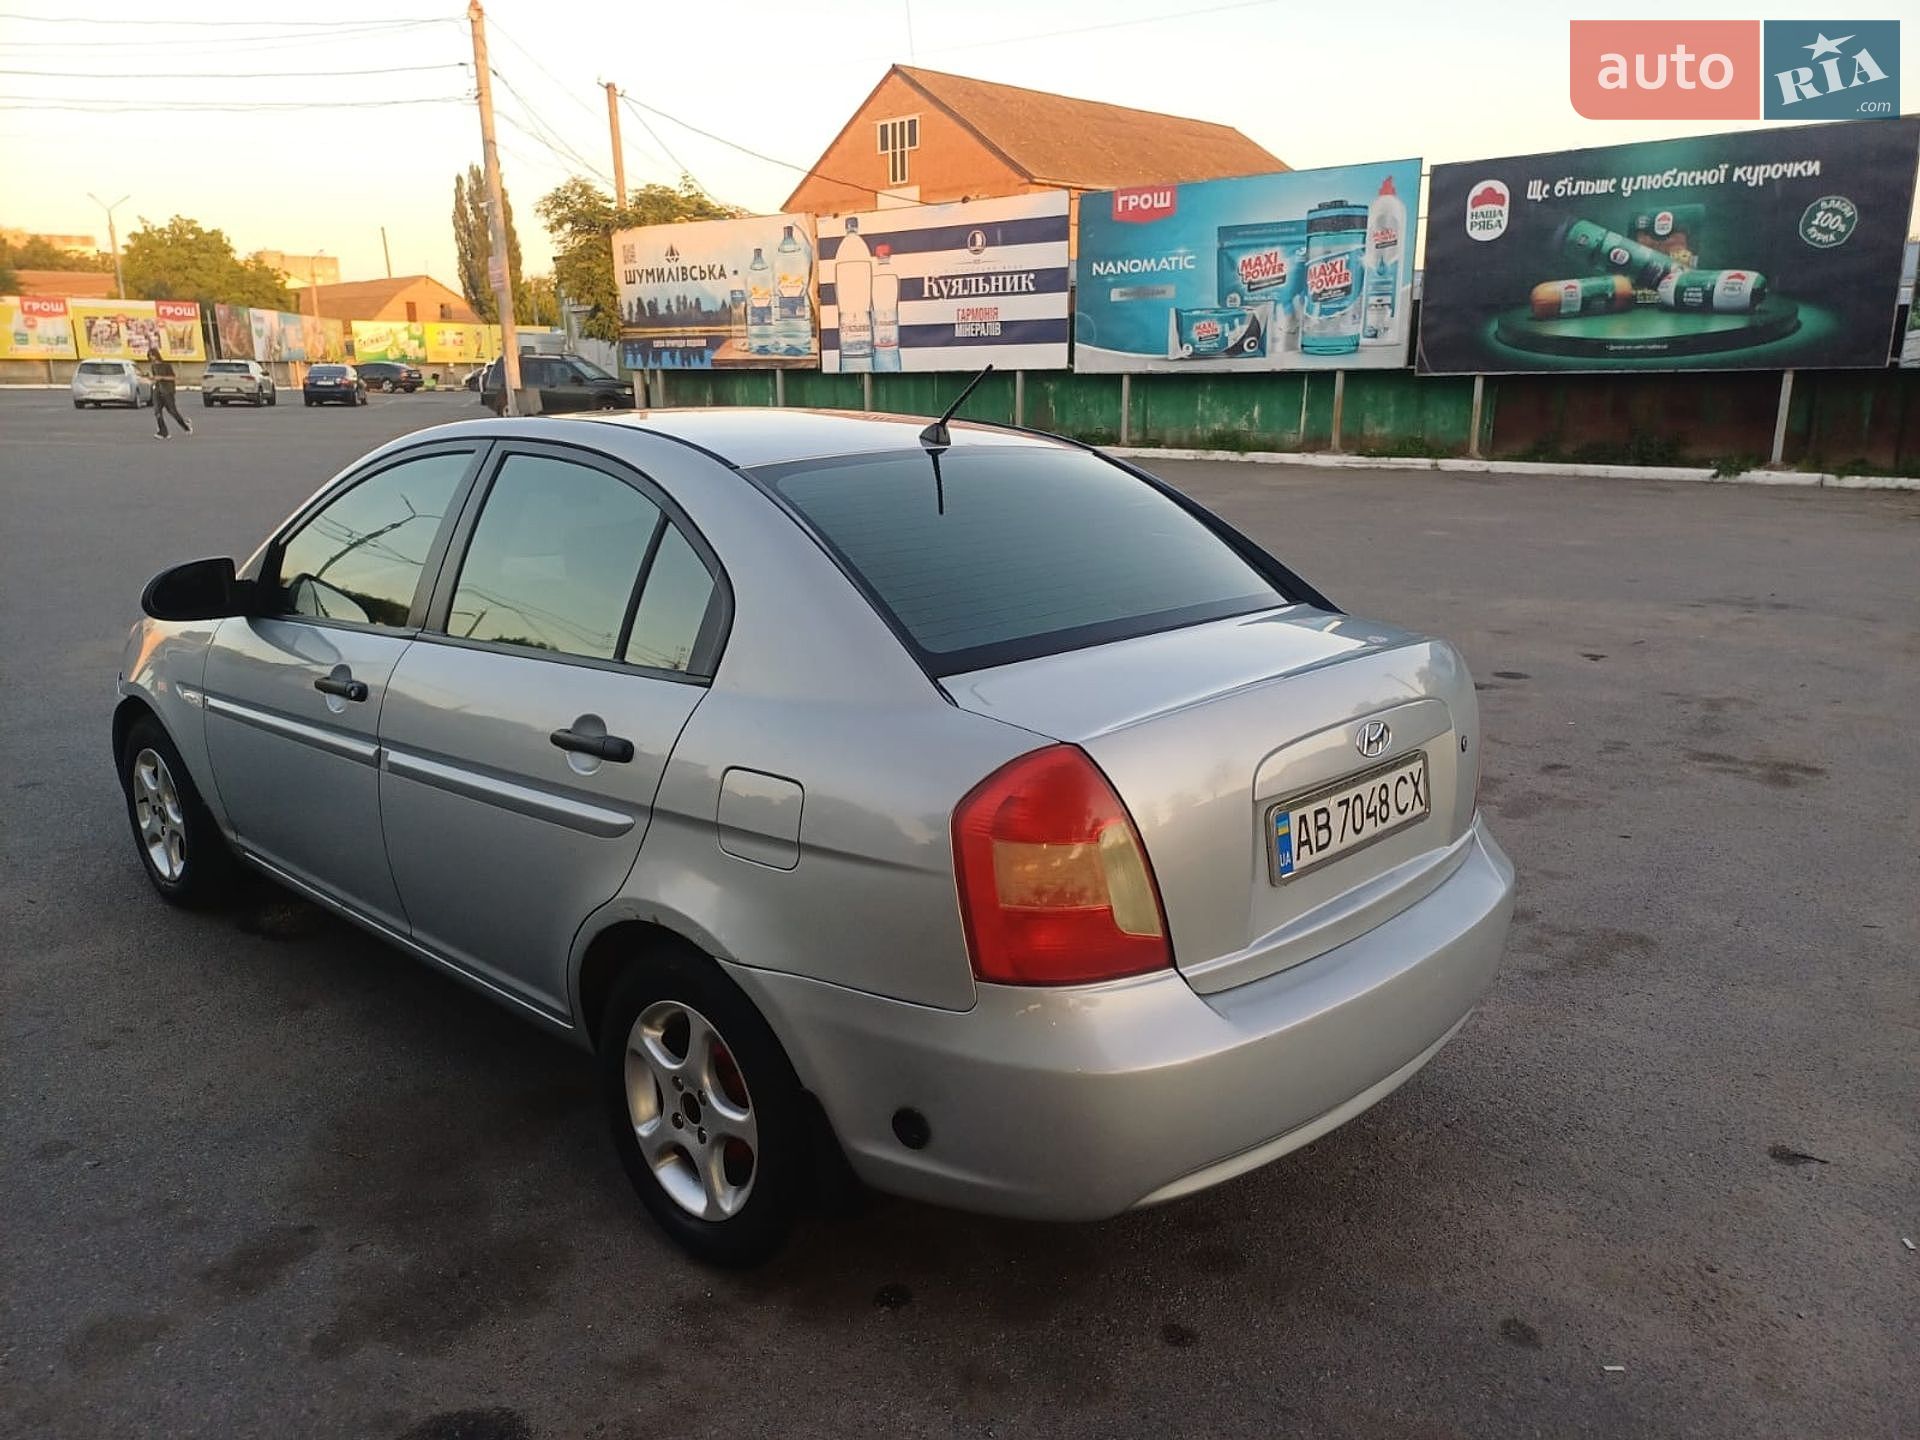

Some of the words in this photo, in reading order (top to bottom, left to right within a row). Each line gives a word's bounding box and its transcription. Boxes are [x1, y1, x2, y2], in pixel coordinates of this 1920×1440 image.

[1526, 179, 1550, 202] Ще
[1554, 177, 1617, 198] більше
[1621, 164, 1729, 197] улюбленої
[1732, 160, 1821, 187] курочки
[1117, 190, 1172, 213] ГРОШ
[1469, 209, 1504, 220] НАША
[1811, 210, 1846, 233] 100%
[1469, 219, 1503, 232] РЯБА
[1091, 255, 1197, 277] NANOMATIC
[1240, 251, 1278, 273] MAXI
[1308, 259, 1344, 280] MAXI
[624, 264, 728, 285] ШУМИЛІВСЬКА
[1244, 263, 1285, 281] POWER
[1310, 272, 1350, 290] POWER
[922, 271, 1037, 302] Куяльник
[23, 301, 65, 313] ГРОШ
[158, 304, 196, 317] ГРОШ
[956, 307, 999, 322] ГАРМОНІЯ
[954, 321, 1002, 338] МІНЕРАЛІВ
[1296, 806, 1332, 861] AB
[1337, 783, 1391, 844] 7048
[1395, 768, 1425, 815] CX
[1280, 851, 1291, 868] UA
